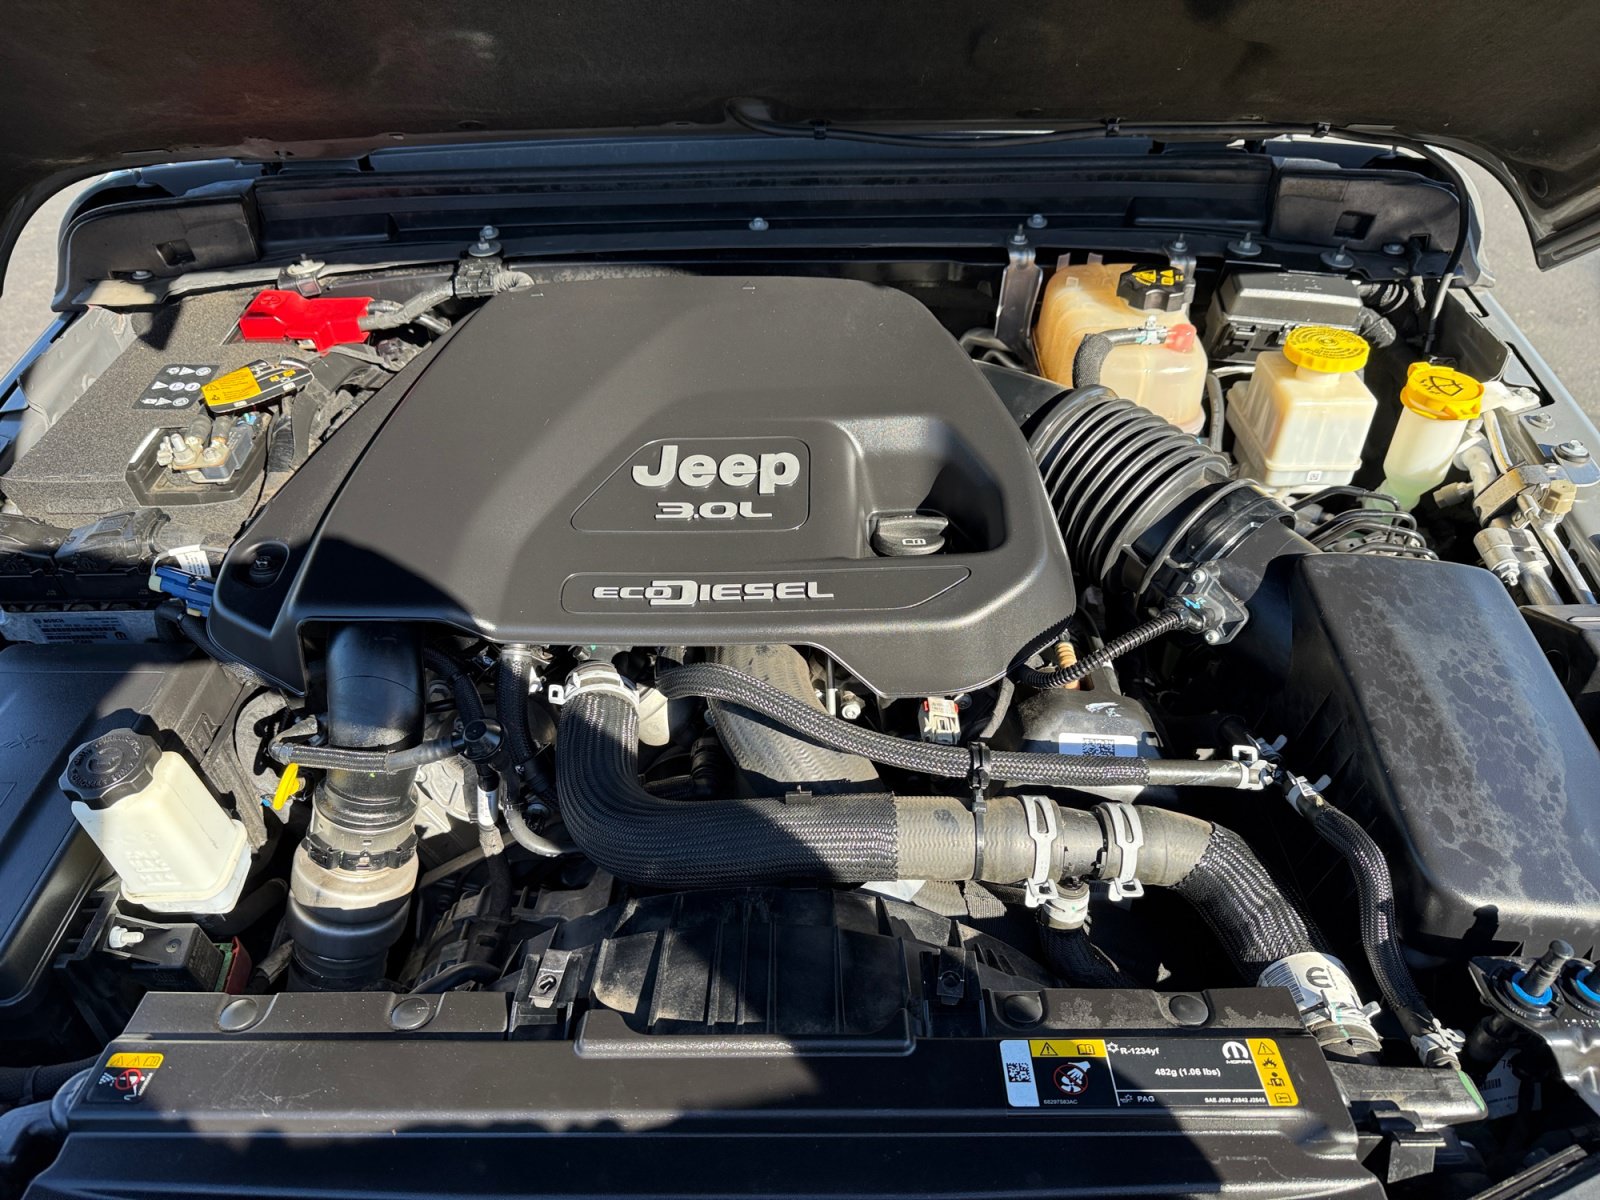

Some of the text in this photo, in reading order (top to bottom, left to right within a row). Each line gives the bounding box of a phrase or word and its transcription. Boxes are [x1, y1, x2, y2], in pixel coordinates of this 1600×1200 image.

[632, 444, 800, 495] Jeep
[655, 501, 773, 520] 3.0L
[1120, 1046, 1160, 1057] R-1234yf
[1154, 1067, 1222, 1078] 482g (1.06 lbs)
[1136, 1095, 1155, 1103] PAG
